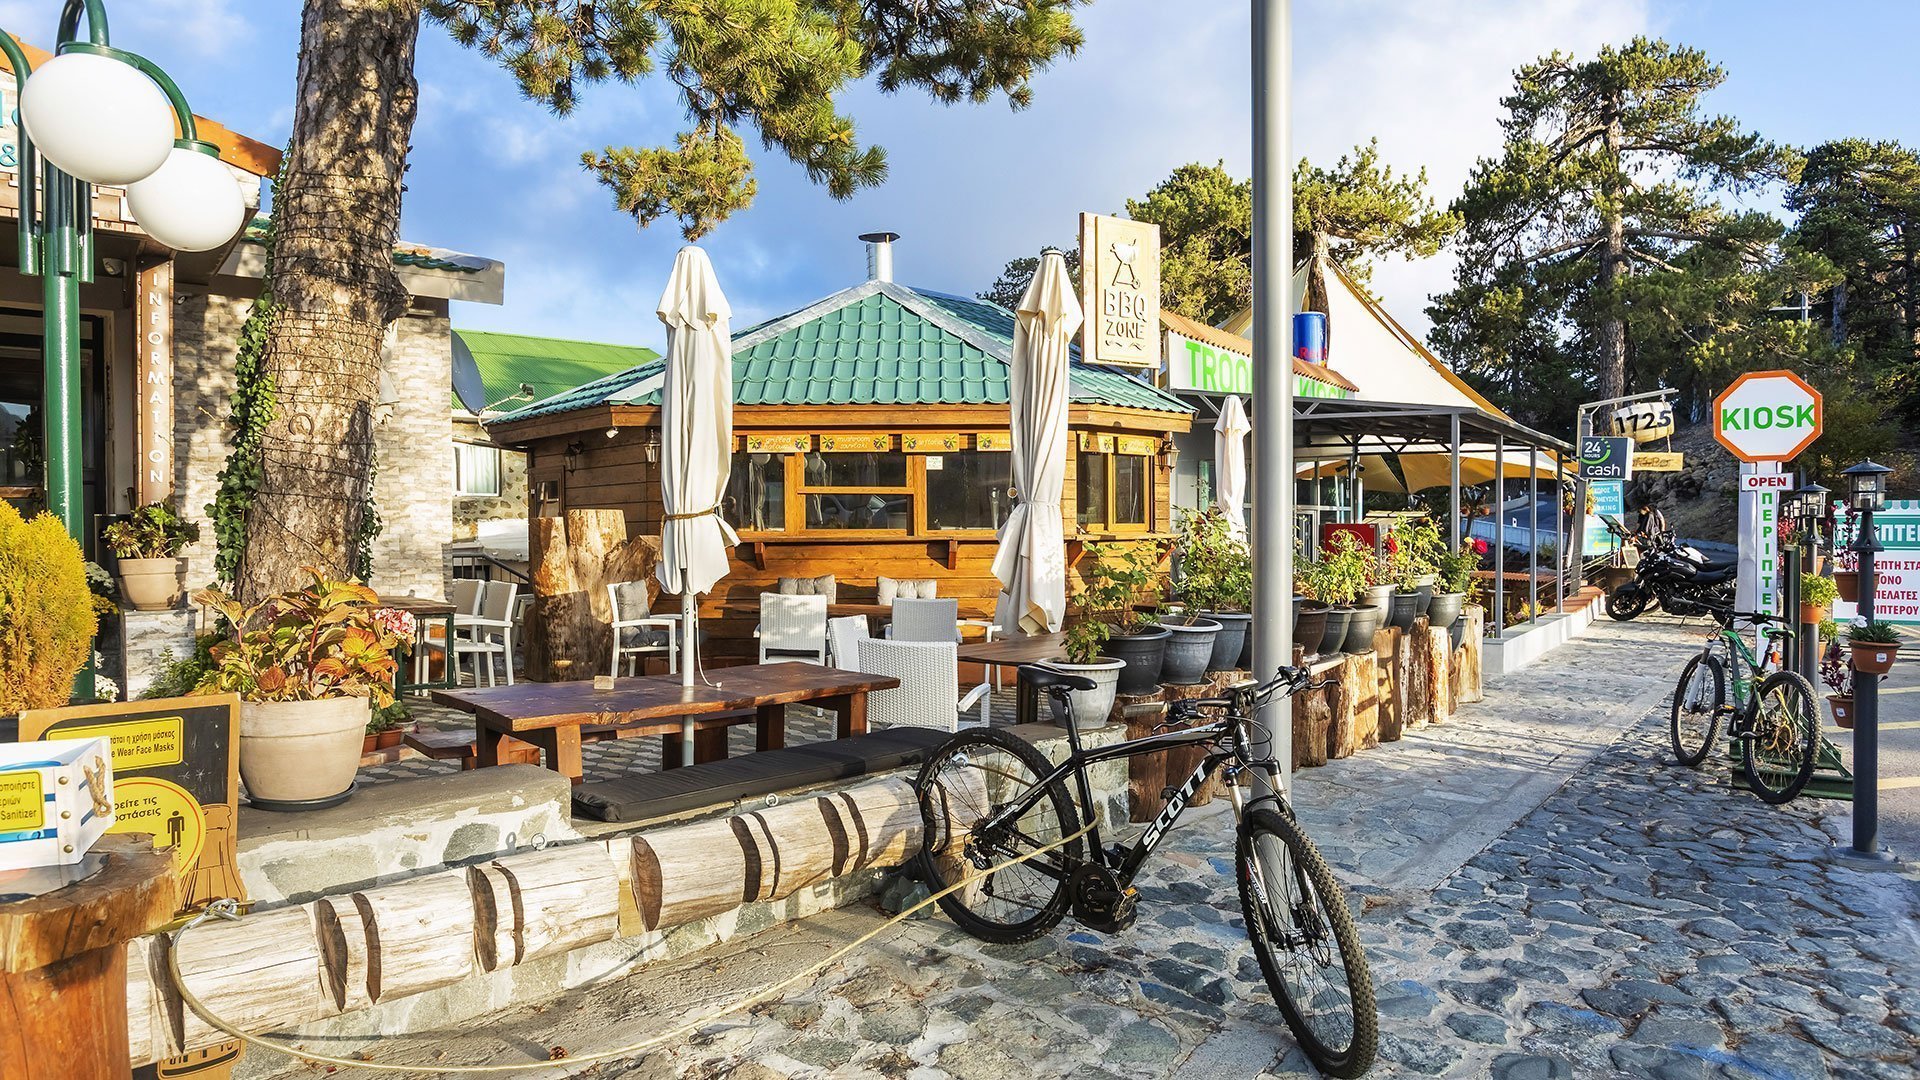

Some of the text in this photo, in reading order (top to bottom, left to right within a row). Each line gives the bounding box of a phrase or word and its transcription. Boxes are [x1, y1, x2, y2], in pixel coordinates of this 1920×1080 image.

[1104, 288, 1147, 323] BBQ
[1105, 319, 1145, 340] ZONE
[1185, 340, 1253, 393] TROO
[147, 272, 165, 484] INFORMATION
[1615, 410, 1672, 433] 1725
[1722, 404, 1817, 431] KIOSK
[1584, 441, 1602, 454] 24
[1586, 464, 1621, 476] cash
[1748, 477, 1787, 487] OPEN
[117, 747, 134, 757] Wear
[136, 745, 152, 755] Face
[153, 742, 175, 753] Masks
[143, 796, 158, 806] τις
[1142, 759, 1208, 852] SCOTT
[1, 809, 37, 820] Sanitizer
